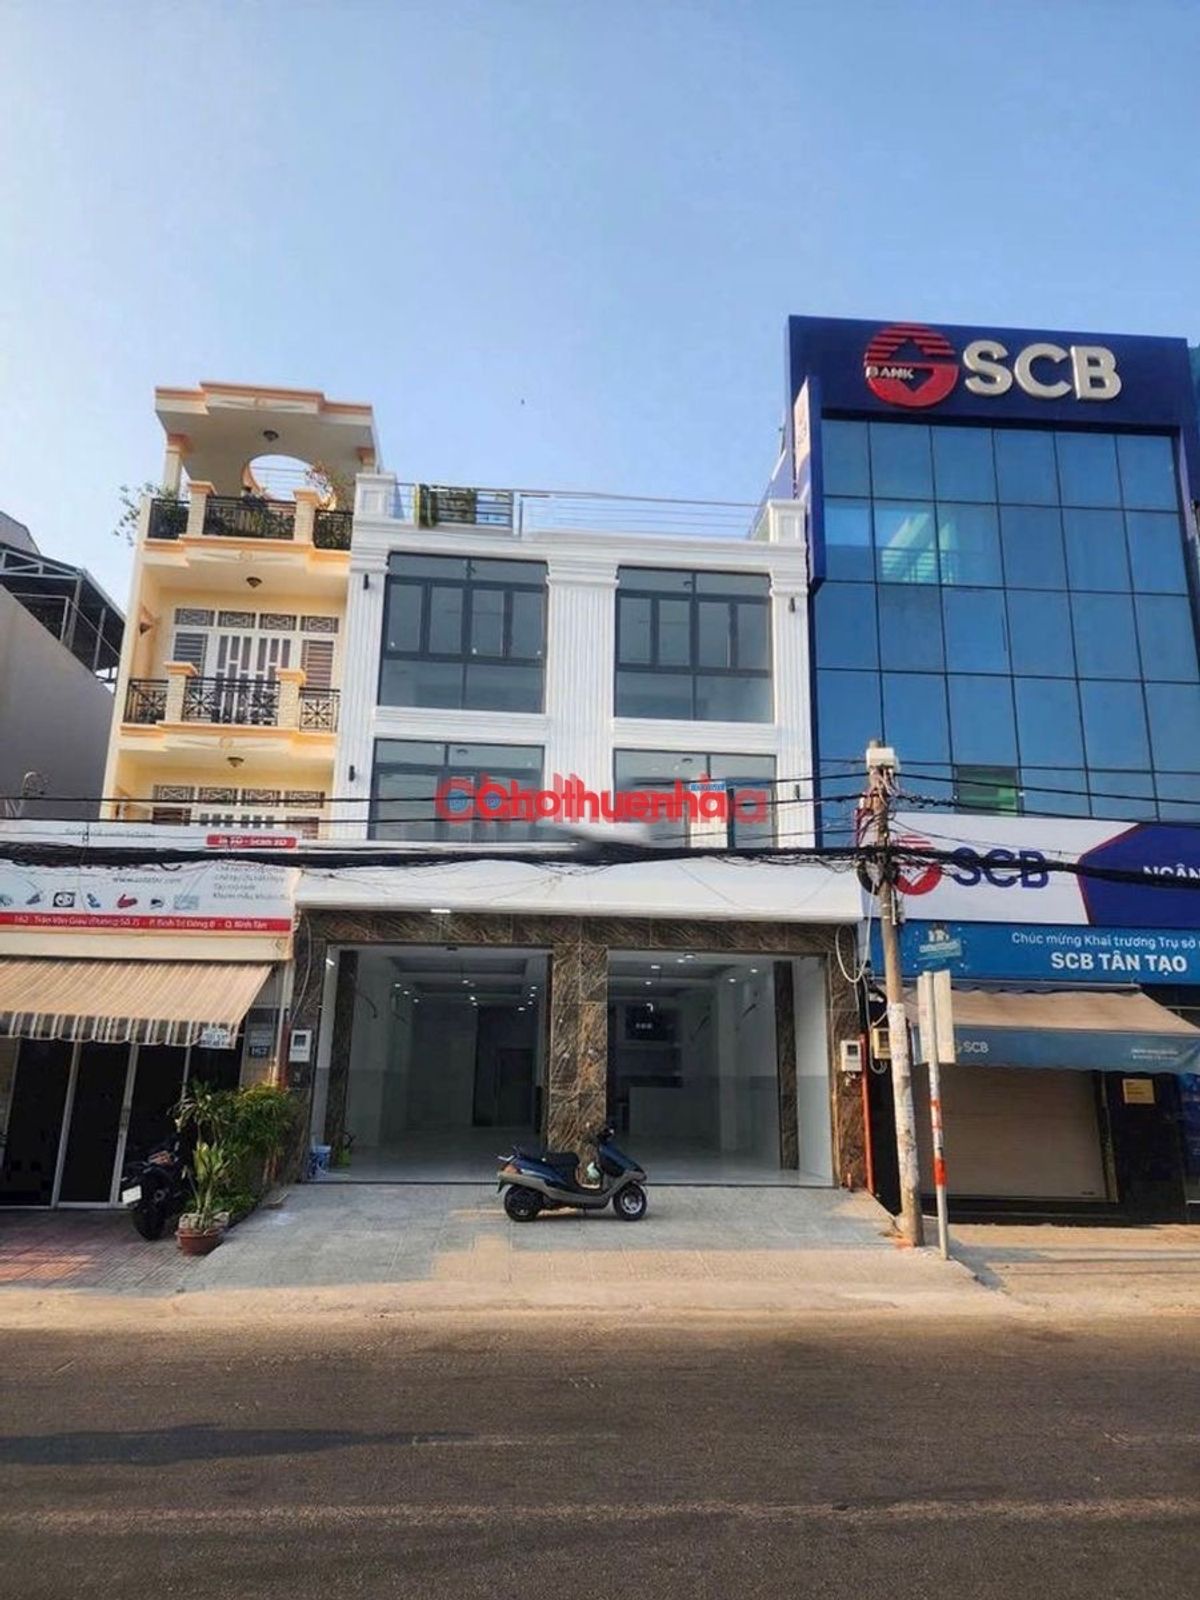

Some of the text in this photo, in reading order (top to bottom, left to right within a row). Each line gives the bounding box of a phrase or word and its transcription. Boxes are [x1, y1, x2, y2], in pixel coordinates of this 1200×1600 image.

[865, 366, 915, 379] BANK
[962, 340, 1123, 401] SCB
[952, 847, 1050, 888] SCB
[1011, 931, 1044, 945] Chúc
[1046, 932, 1082, 948] mừng
[1084, 935, 1112, 947] Khai
[1113, 936, 1156, 949] trương
[1158, 937, 1179, 950] Trụ
[1180, 939, 1197, 949] sở
[1050, 950, 1188, 976] SCB TÂN TẠO
[963, 1041, 989, 1053] SCB
